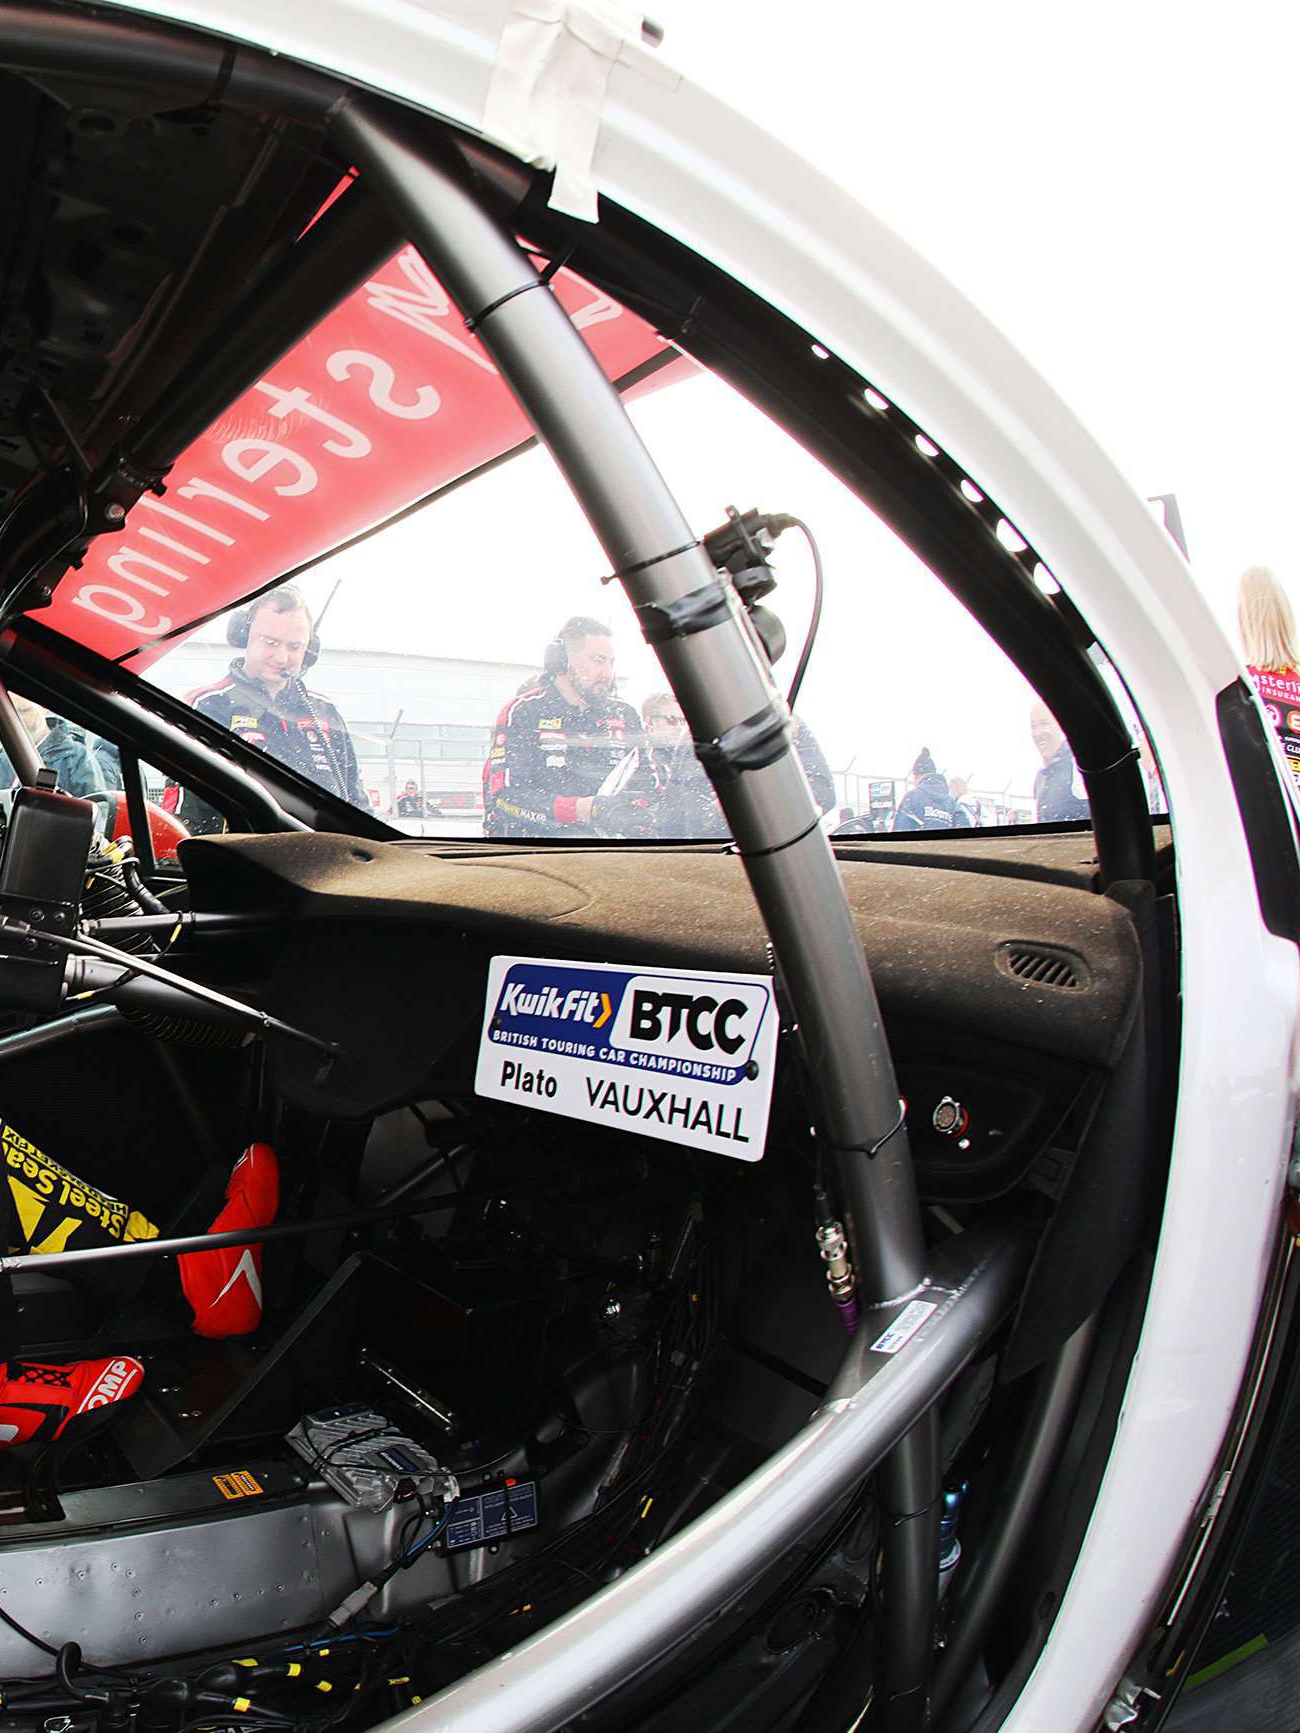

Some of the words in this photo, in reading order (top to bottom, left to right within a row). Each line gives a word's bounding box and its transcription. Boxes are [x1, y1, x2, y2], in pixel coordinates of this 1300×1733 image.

[629, 989, 749, 1055] BTCC
[492, 1029, 538, 1047] BRITISH
[541, 1038, 596, 1058] TOURING
[599, 1047, 626, 1064] CAR
[629, 1052, 738, 1083] CHAMPIONSHIP
[500, 1060, 557, 1098] Plato
[586, 1077, 750, 1144] VAUXHALL
[59, 1180, 124, 1239] Steel
[88, 1361, 127, 1409] OMP
